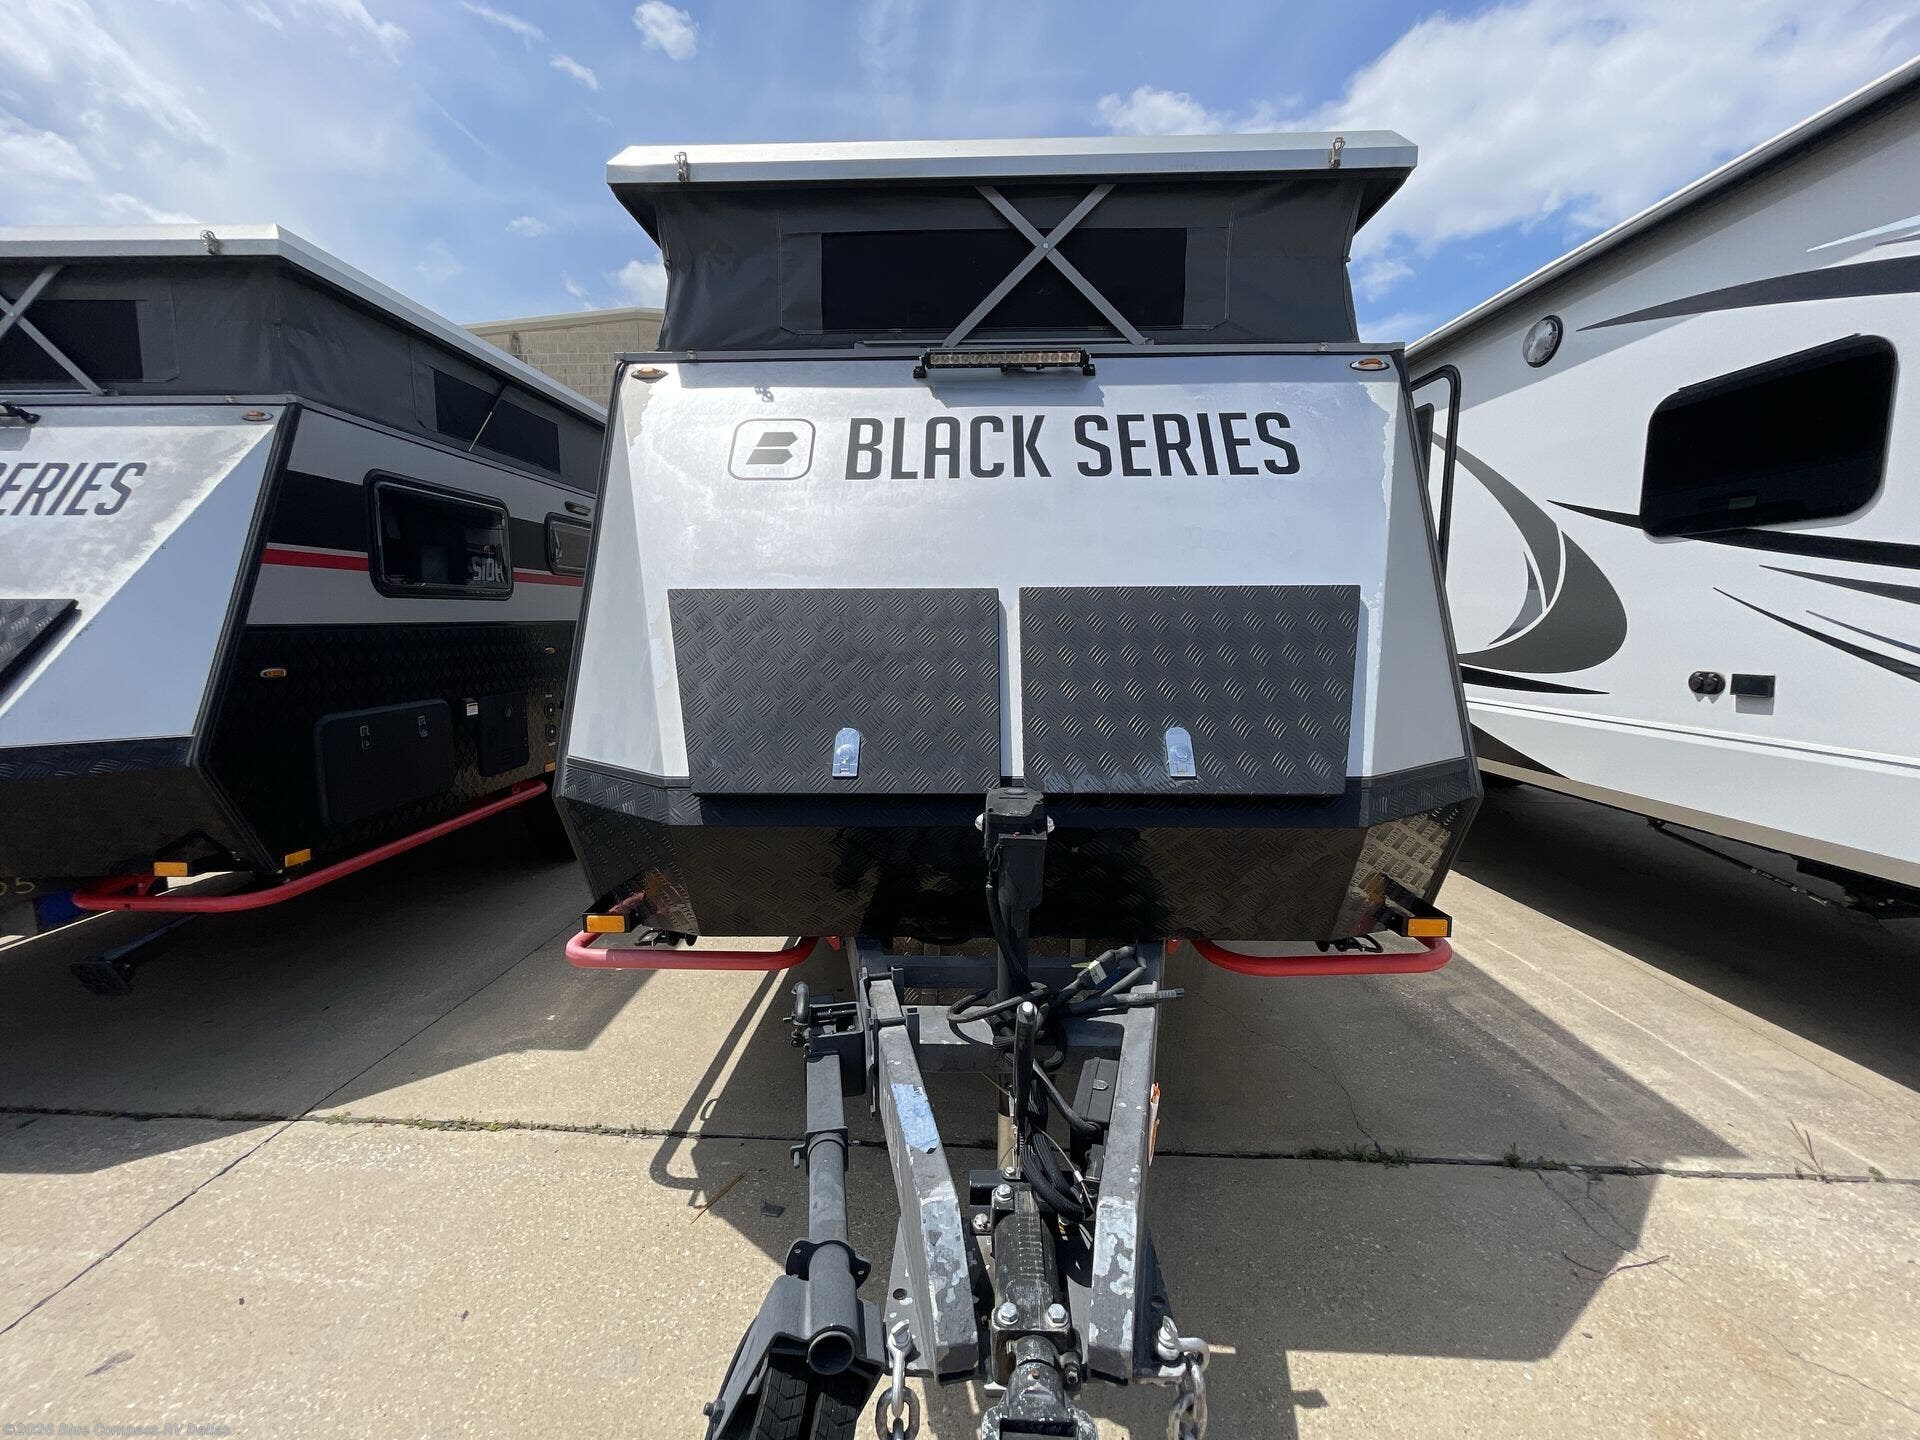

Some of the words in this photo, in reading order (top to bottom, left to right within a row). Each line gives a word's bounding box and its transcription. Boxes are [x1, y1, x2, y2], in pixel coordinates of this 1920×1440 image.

[845, 415, 1052, 480] BLACK
[1074, 412, 1300, 476] SERIES
[0, 462, 147, 516] ERIES
